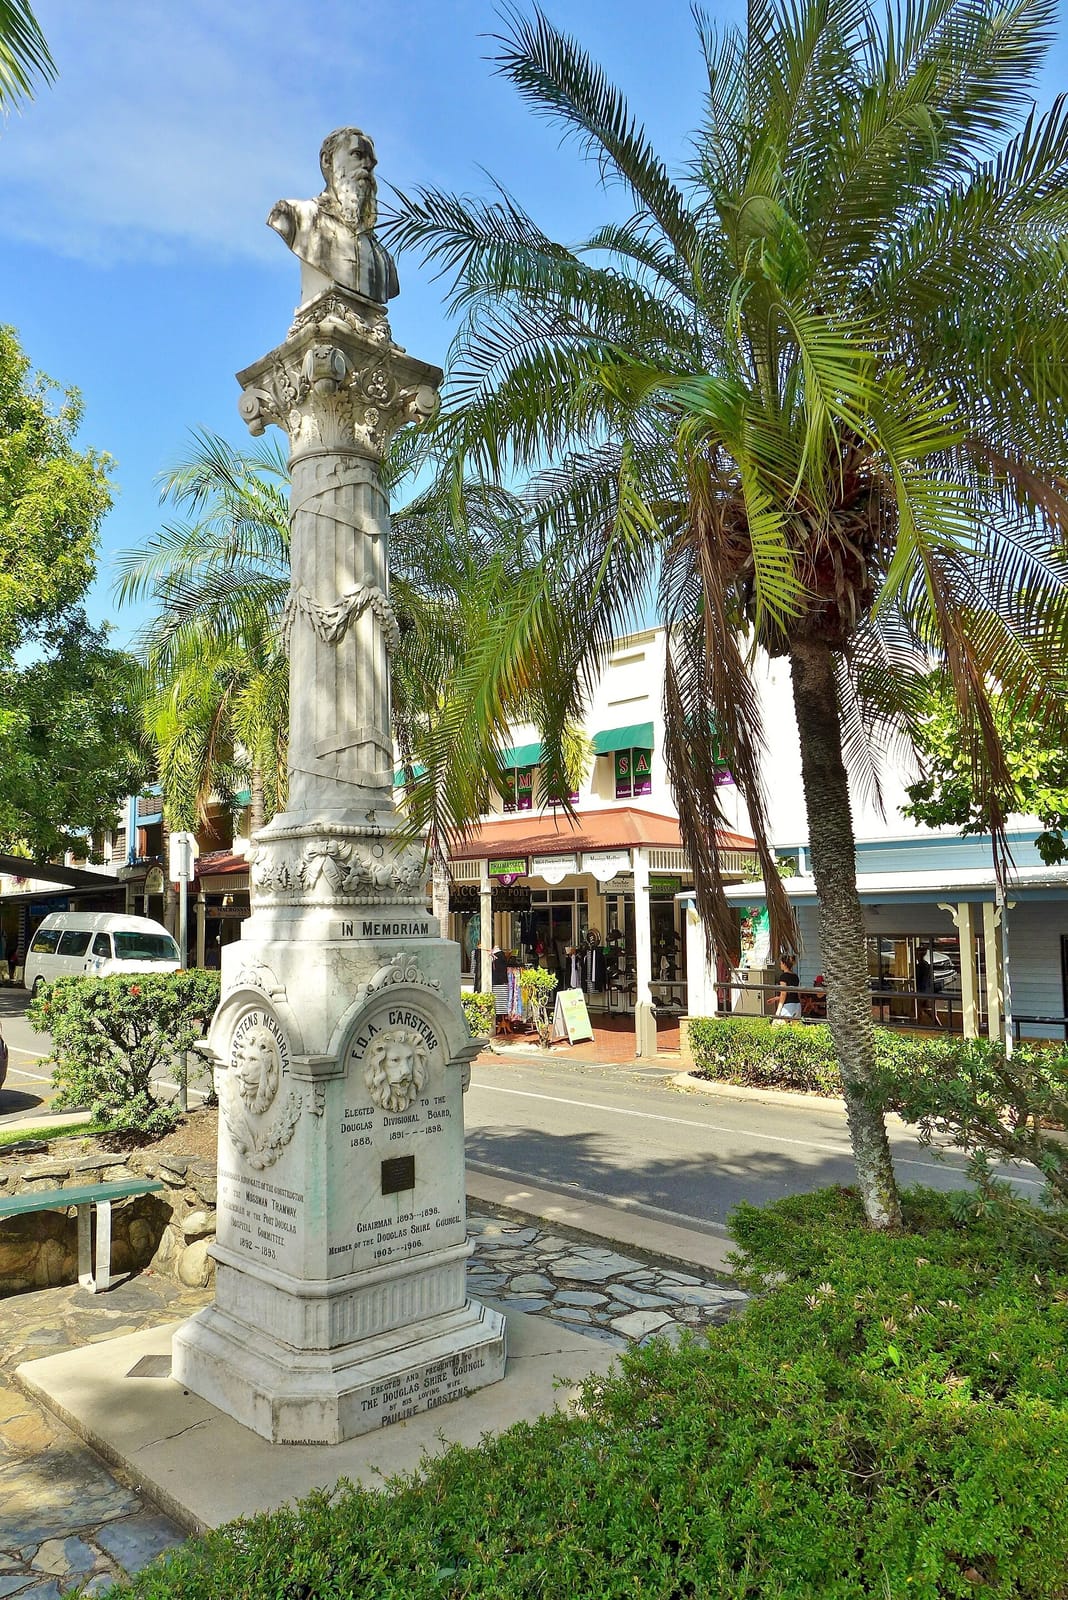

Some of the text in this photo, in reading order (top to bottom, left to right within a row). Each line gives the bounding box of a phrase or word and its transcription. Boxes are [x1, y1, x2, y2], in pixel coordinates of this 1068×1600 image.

[450, 886, 498, 897] PICCO
[342, 922, 428, 936] IN MEMORIAM
[232, 1012, 290, 1078] CARSTENS MEMORIAL
[344, 1107, 374, 1118] ELECTED
[434, 1096, 446, 1104] THE
[341, 1121, 373, 1134] DOUGLAS
[384, 1114, 420, 1127] DIVISIONAL
[356, 1218, 392, 1233] CHAIRMAN
[328, 1244, 352, 1256] MEMBER
[377, 1228, 407, 1243] DOUGLAS
[410, 1223, 430, 1234] SHIRE
[361, 1359, 485, 1412] THE DOUGLAS SHIRE COUNCIL
[370, 1380, 400, 1396] ERECTED
[406, 1372, 419, 1383] AND
[381, 1386, 468, 1427] PAULINE CARSTENS
[390, 1403, 397, 1412] BY
[402, 1397, 412, 1406] HIS
[418, 1387, 440, 1400] LOVING
